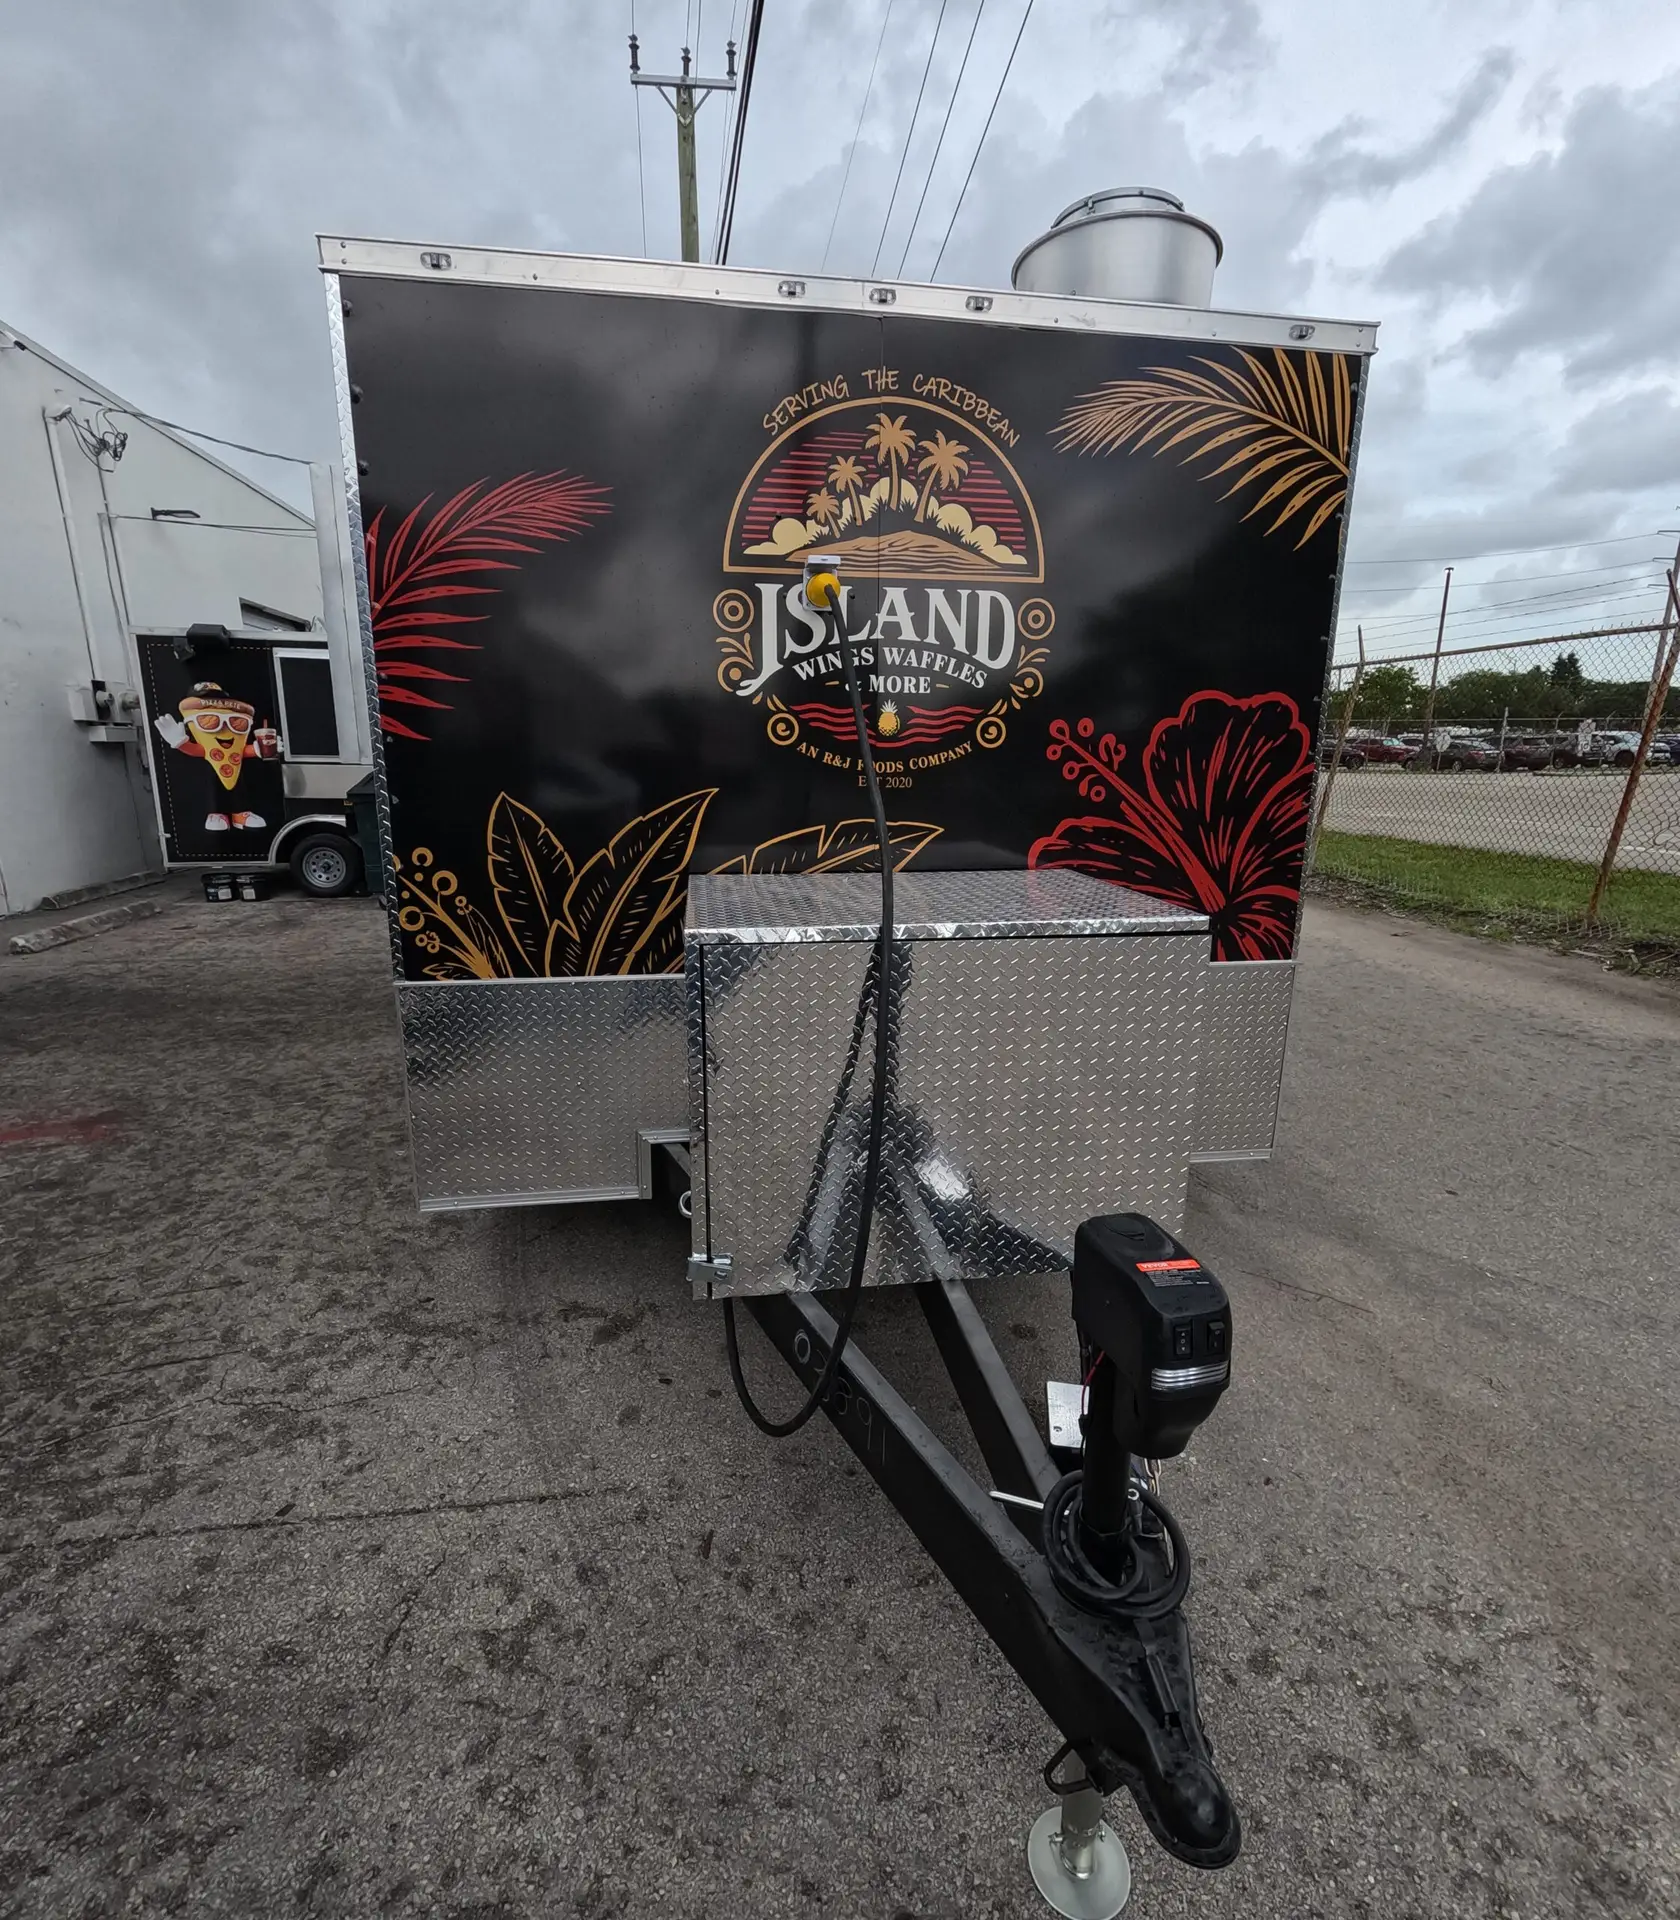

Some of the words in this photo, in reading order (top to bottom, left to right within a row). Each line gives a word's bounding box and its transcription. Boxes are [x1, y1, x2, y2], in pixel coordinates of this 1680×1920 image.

[762, 374, 850, 436] SERVING
[861, 366, 899, 392] THE
[912, 373, 1021, 448] CARIBBEAN
[868, 674, 931, 694] MORE
[882, 646, 988, 689] WAFFLES
[796, 741, 820, 759] AN
[822, 751, 851, 769] R&J
[857, 759, 904, 774] FODS
[909, 740, 972, 770] COMPANY
[858, 775, 883, 788] ET
[885, 776, 913, 788] 2020
